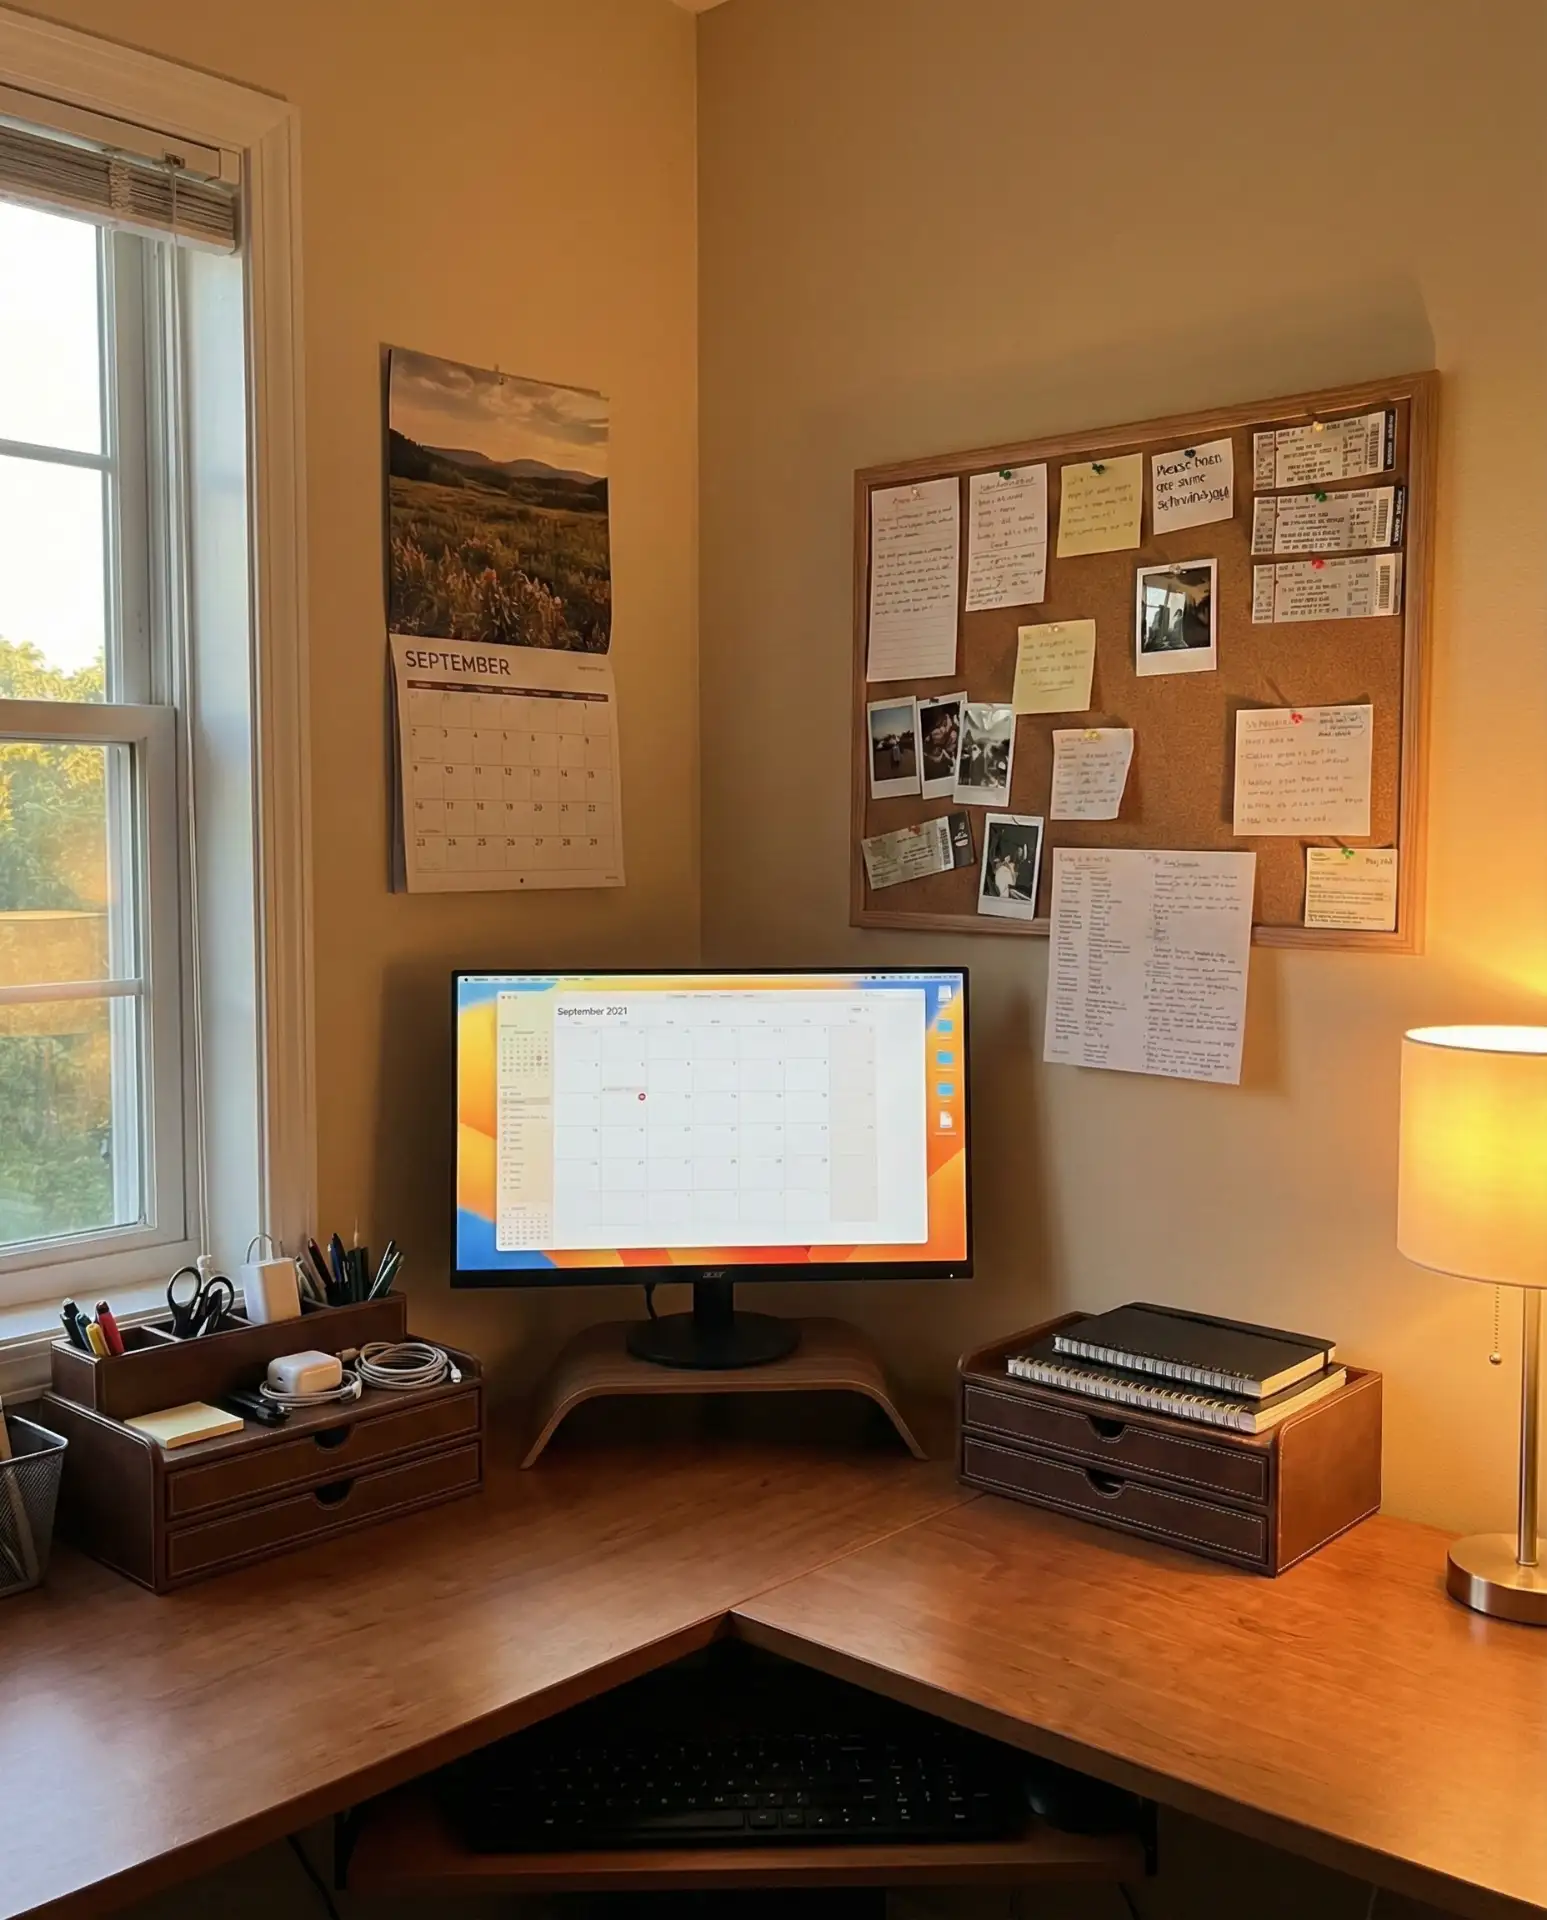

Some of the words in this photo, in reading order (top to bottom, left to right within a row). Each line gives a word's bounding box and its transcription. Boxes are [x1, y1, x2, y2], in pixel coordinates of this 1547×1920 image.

[405, 650, 511, 675] SEPTEMBER
[557, 1007, 605, 1017] September
[606, 1006, 628, 1016] 2021
